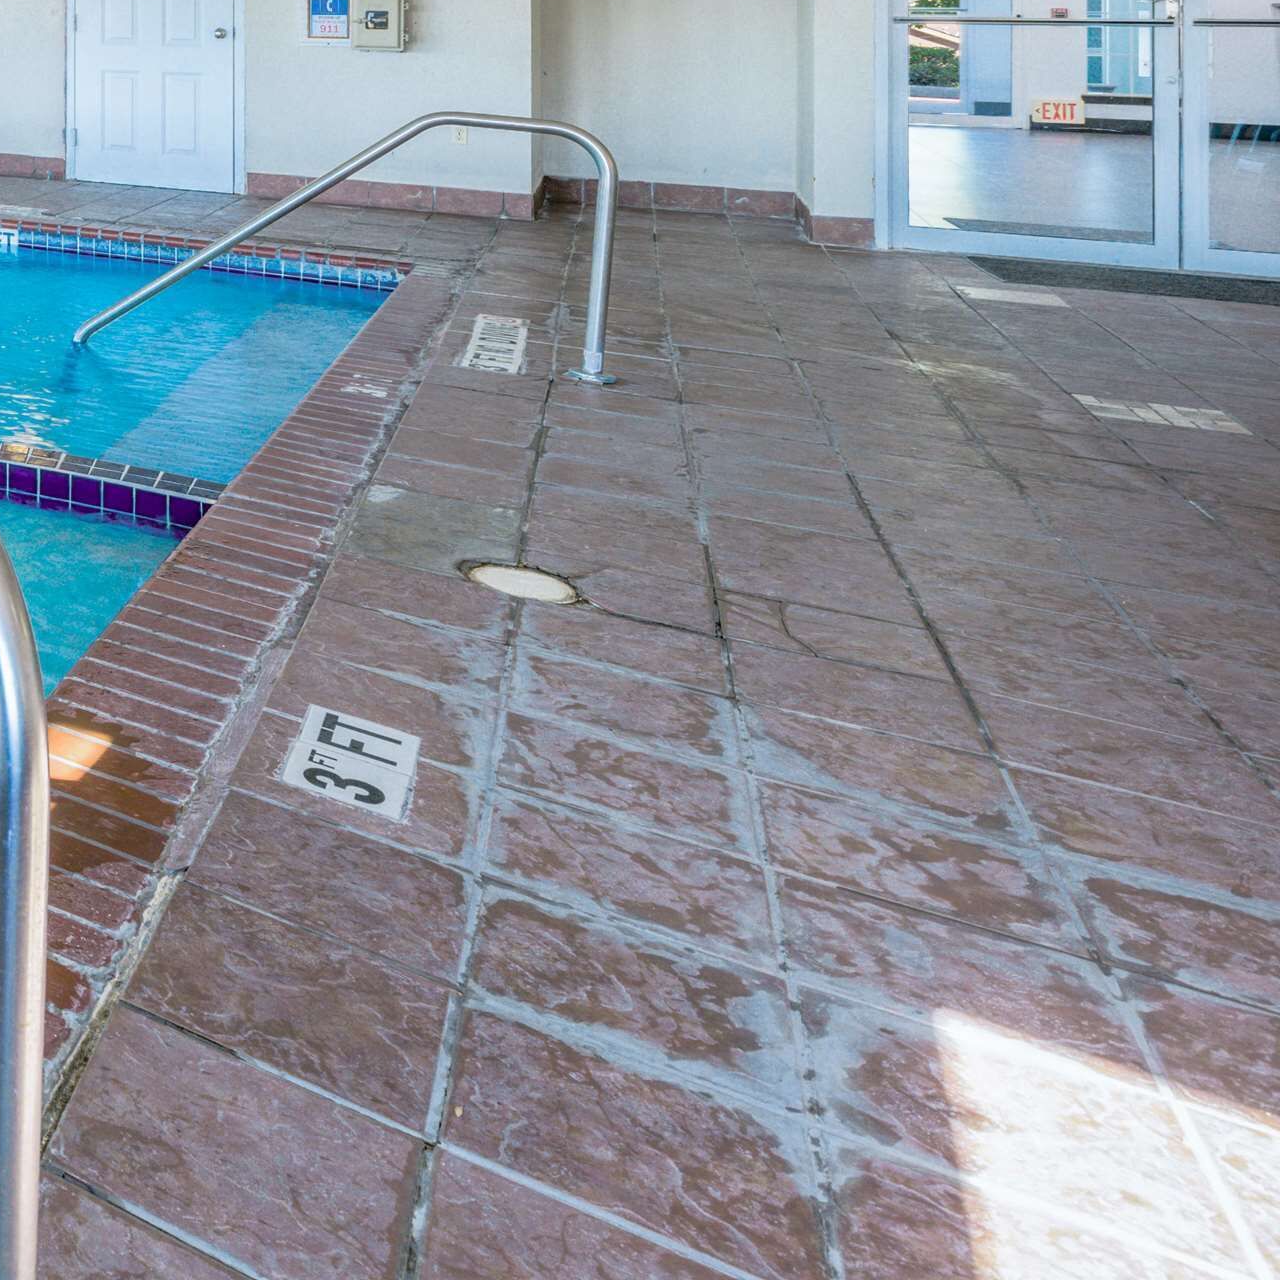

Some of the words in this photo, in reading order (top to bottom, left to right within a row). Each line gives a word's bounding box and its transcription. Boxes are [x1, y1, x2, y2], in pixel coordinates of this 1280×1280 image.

[320, 24, 338, 33] 911
[1042, 102, 1077, 120] EXIT
[316, 712, 403, 767] FT
[308, 749, 338, 770] FT
[302, 767, 386, 806] 3
